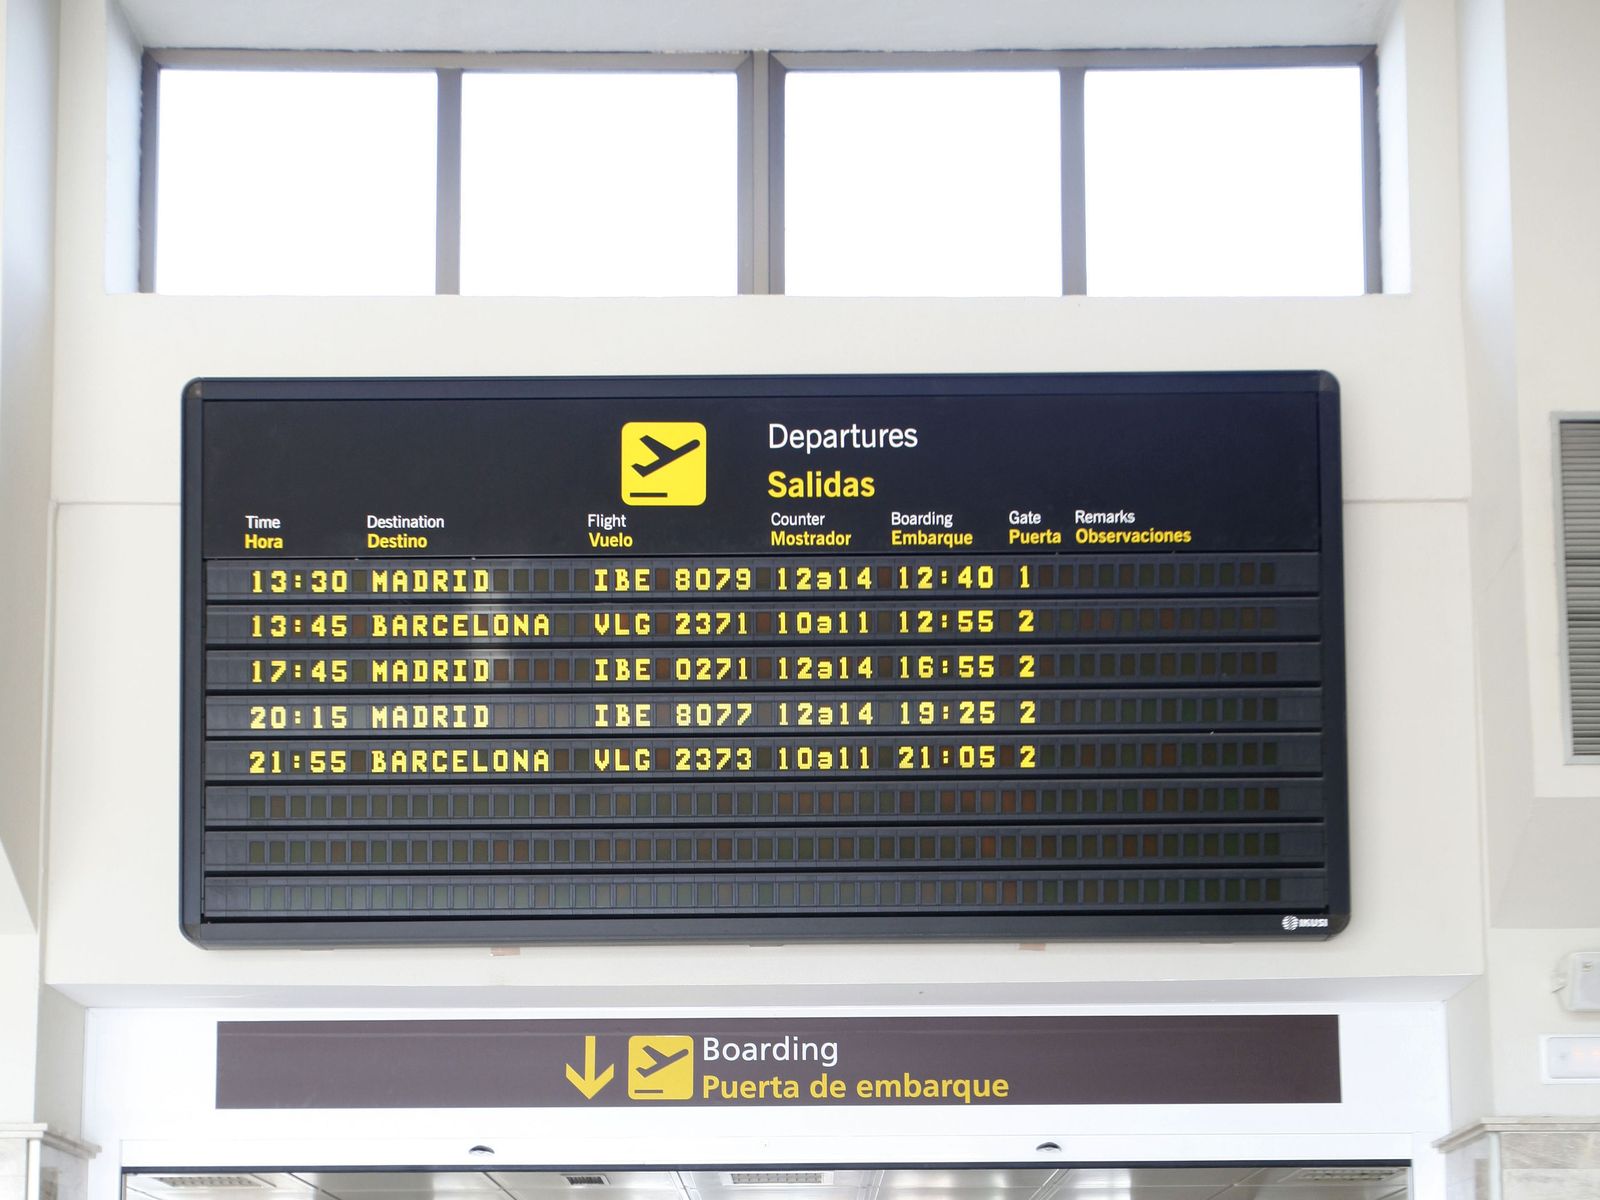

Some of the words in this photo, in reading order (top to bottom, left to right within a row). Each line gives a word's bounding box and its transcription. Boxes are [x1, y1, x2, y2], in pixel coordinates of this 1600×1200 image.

[769, 424, 918, 454] Departures
[768, 471, 875, 498] Salidas
[245, 516, 280, 528] Time
[367, 515, 444, 528] Destination
[588, 514, 626, 530] Flight
[771, 512, 825, 526] Counter
[892, 511, 953, 527] Boarding
[1009, 511, 1041, 524] Gate
[1075, 510, 1135, 523] Remarks
[245, 534, 283, 548] Hora
[368, 534, 427, 548] Destino
[589, 532, 633, 547] Vuelo
[771, 531, 851, 545] Mostrador
[892, 530, 973, 548] Embarque
[1009, 529, 1061, 544] Puerta
[1076, 528, 1191, 543] Observaciones
[253, 571, 347, 592] 13:30
[373, 570, 488, 592] MADRID
[595, 569, 649, 591] IBE
[676, 568, 750, 590] 8079
[779, 567, 871, 589] 12a14
[900, 566, 993, 588] 12:40
[1021, 566, 1029, 587] 1
[253, 615, 346, 636] 13:45
[373, 614, 548, 636] BARCELONA
[595, 614, 649, 635] VLG
[676, 613, 746, 634] 2371
[779, 612, 868, 633] 10a11
[900, 611, 993, 632] 12:55
[1019, 610, 1033, 631] 2
[253, 661, 346, 682] 17:45
[373, 659, 488, 682] MADRID
[596, 659, 650, 680] IBE
[676, 658, 747, 680] 0271
[779, 657, 872, 679] 12a14
[901, 656, 994, 678] 16:55
[1020, 656, 1034, 677] 2
[251, 706, 347, 728] 20:15
[373, 705, 488, 728] MADRID
[596, 704, 650, 726] IBE
[677, 704, 751, 726] 8077
[780, 703, 873, 725] 12a14
[901, 701, 994, 724] 19:25
[1021, 701, 1035, 723] 2
[250, 751, 345, 773] 21:55
[372, 750, 548, 772] BARCELONA
[595, 749, 649, 771] VLG
[676, 748, 751, 770] 2373
[780, 747, 869, 769] 10a11
[899, 746, 994, 768] 21:05
[1021, 746, 1035, 767] 2
[704, 1036, 837, 1067] Boarding
[703, 1075, 799, 1098] Puerta
[810, 1073, 846, 1098] de
[857, 1073, 1008, 1103] embarque
